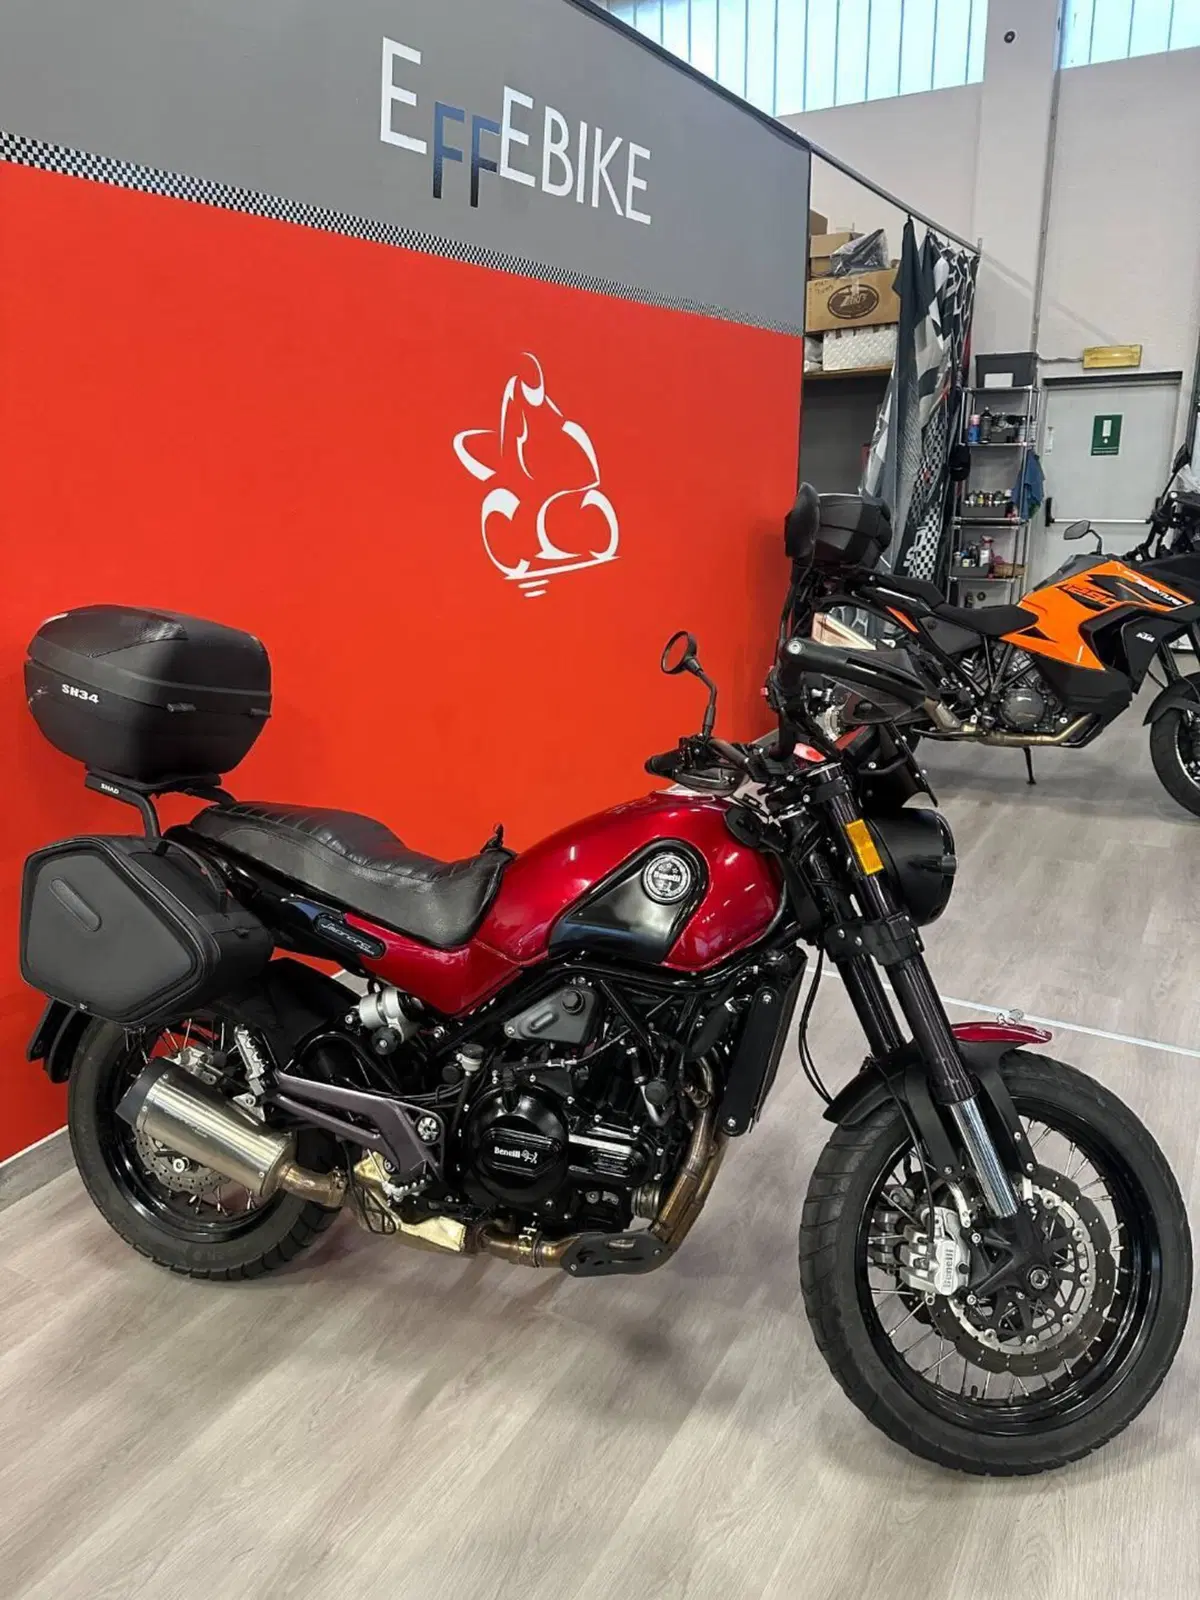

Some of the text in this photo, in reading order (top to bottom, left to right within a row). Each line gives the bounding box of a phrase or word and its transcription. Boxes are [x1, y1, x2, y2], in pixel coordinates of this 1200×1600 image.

[380, 36, 651, 225] EFFEBIKE
[1136, 631, 1155, 643] KTM
[61, 684, 99, 703] SH34
[101, 783, 120, 794] SHAD
[494, 1146, 520, 1158] Benelli
